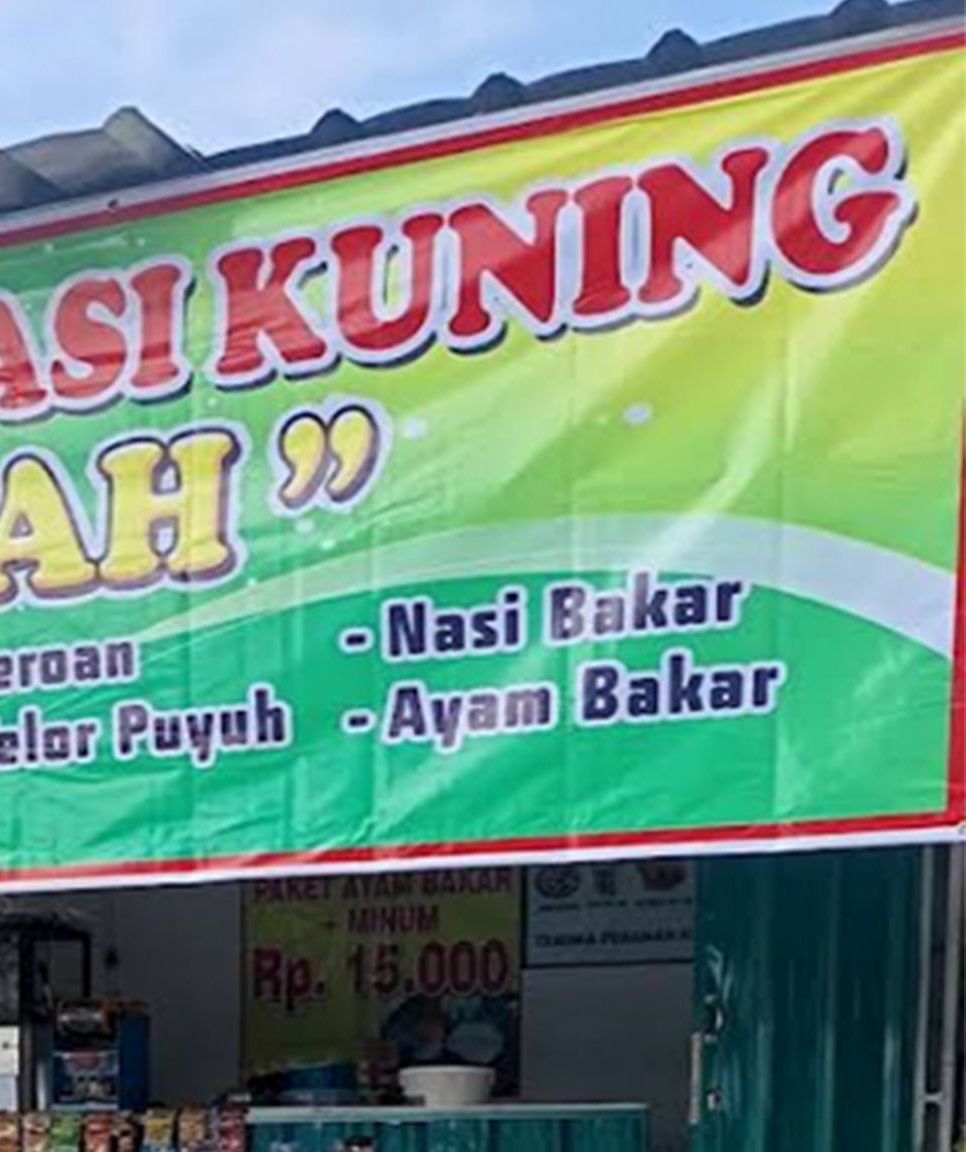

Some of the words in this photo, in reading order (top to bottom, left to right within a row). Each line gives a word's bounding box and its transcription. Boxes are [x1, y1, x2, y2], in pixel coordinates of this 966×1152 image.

[212, 124, 904, 377] KUNING
[549, 572, 743, 640] Bakar
[582, 654, 780, 721] Bakar
[118, 691, 287, 763] Puyuh
[253, 875, 331, 903] PAKET
[342, 870, 413, 899] AYAM
[422, 866, 513, 897] BAKAR
[348, 904, 440, 934] MINUM
[253, 945, 326, 1013] Rp.
[347, 938, 509, 999] 15.000
